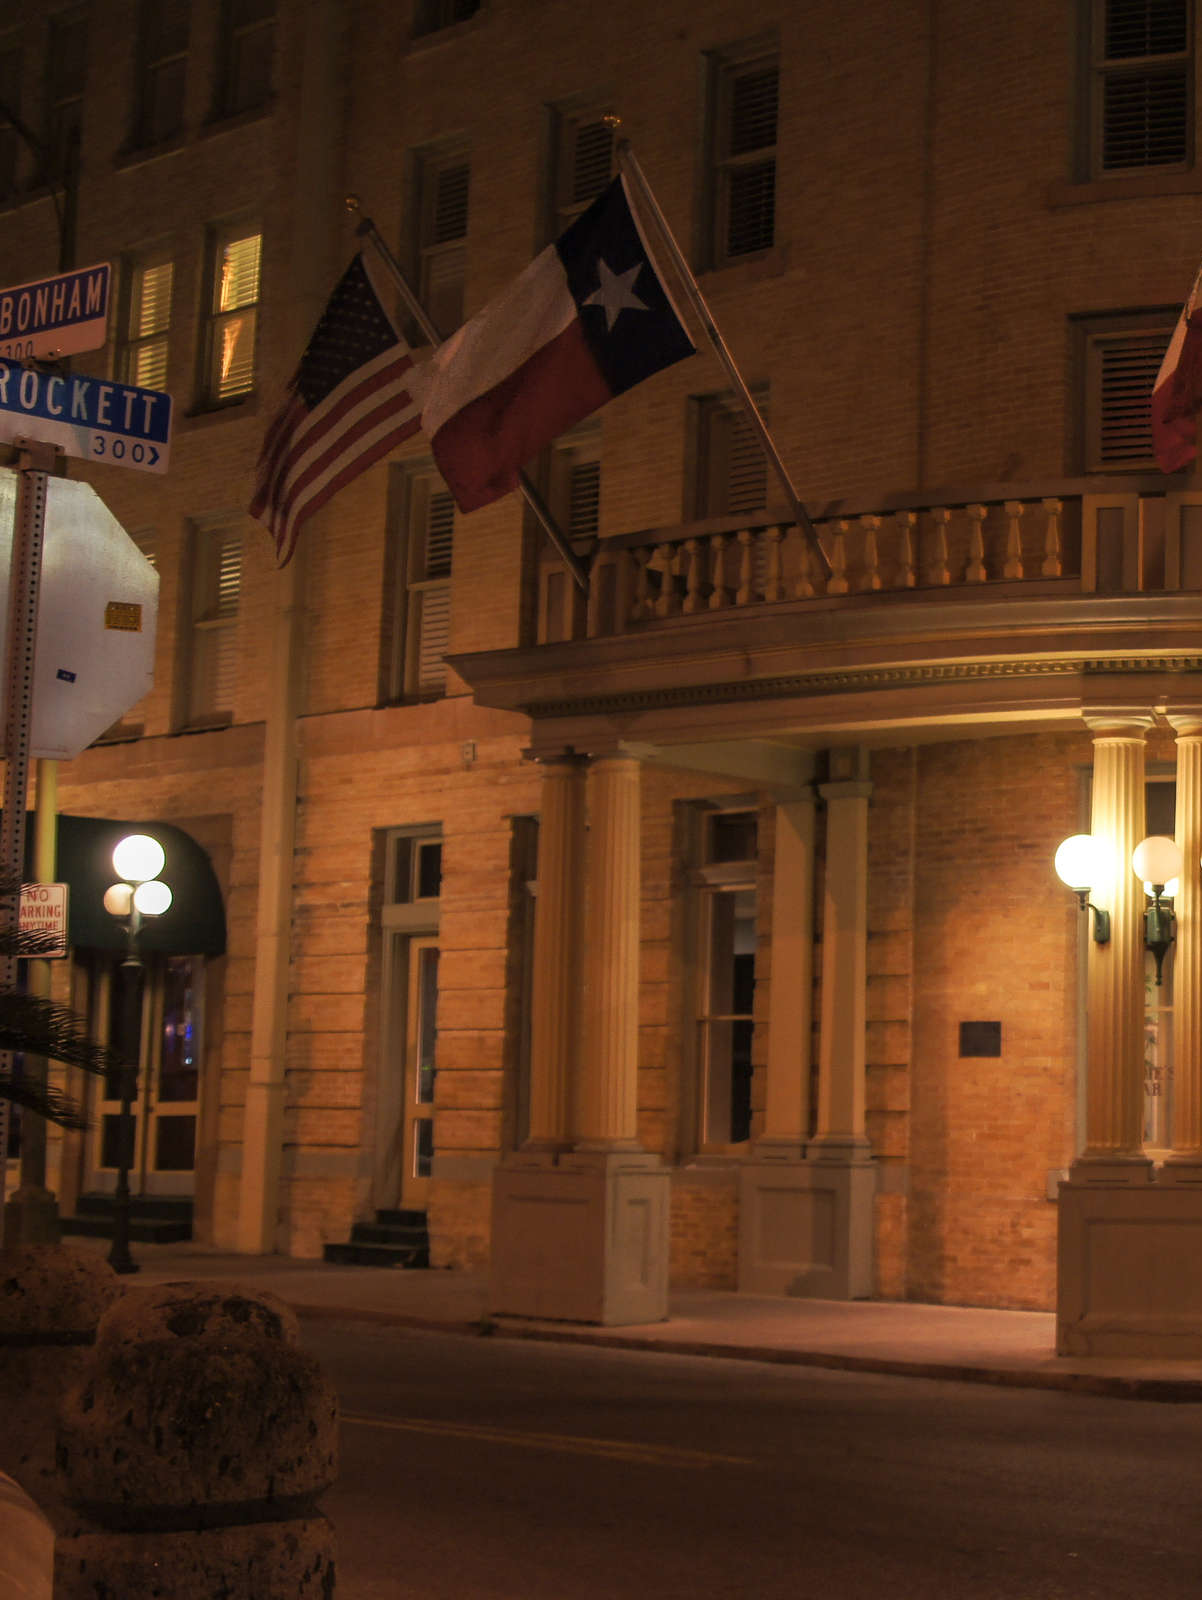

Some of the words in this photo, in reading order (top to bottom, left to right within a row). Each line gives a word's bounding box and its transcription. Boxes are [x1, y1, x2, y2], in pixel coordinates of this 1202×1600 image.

[0, 272, 104, 335] BONHAM
[0, 362, 157, 434] ROCKETT
[93, 436, 145, 463] 300
[26, 888, 49, 902] NO
[20, 904, 61, 918] ARKING
